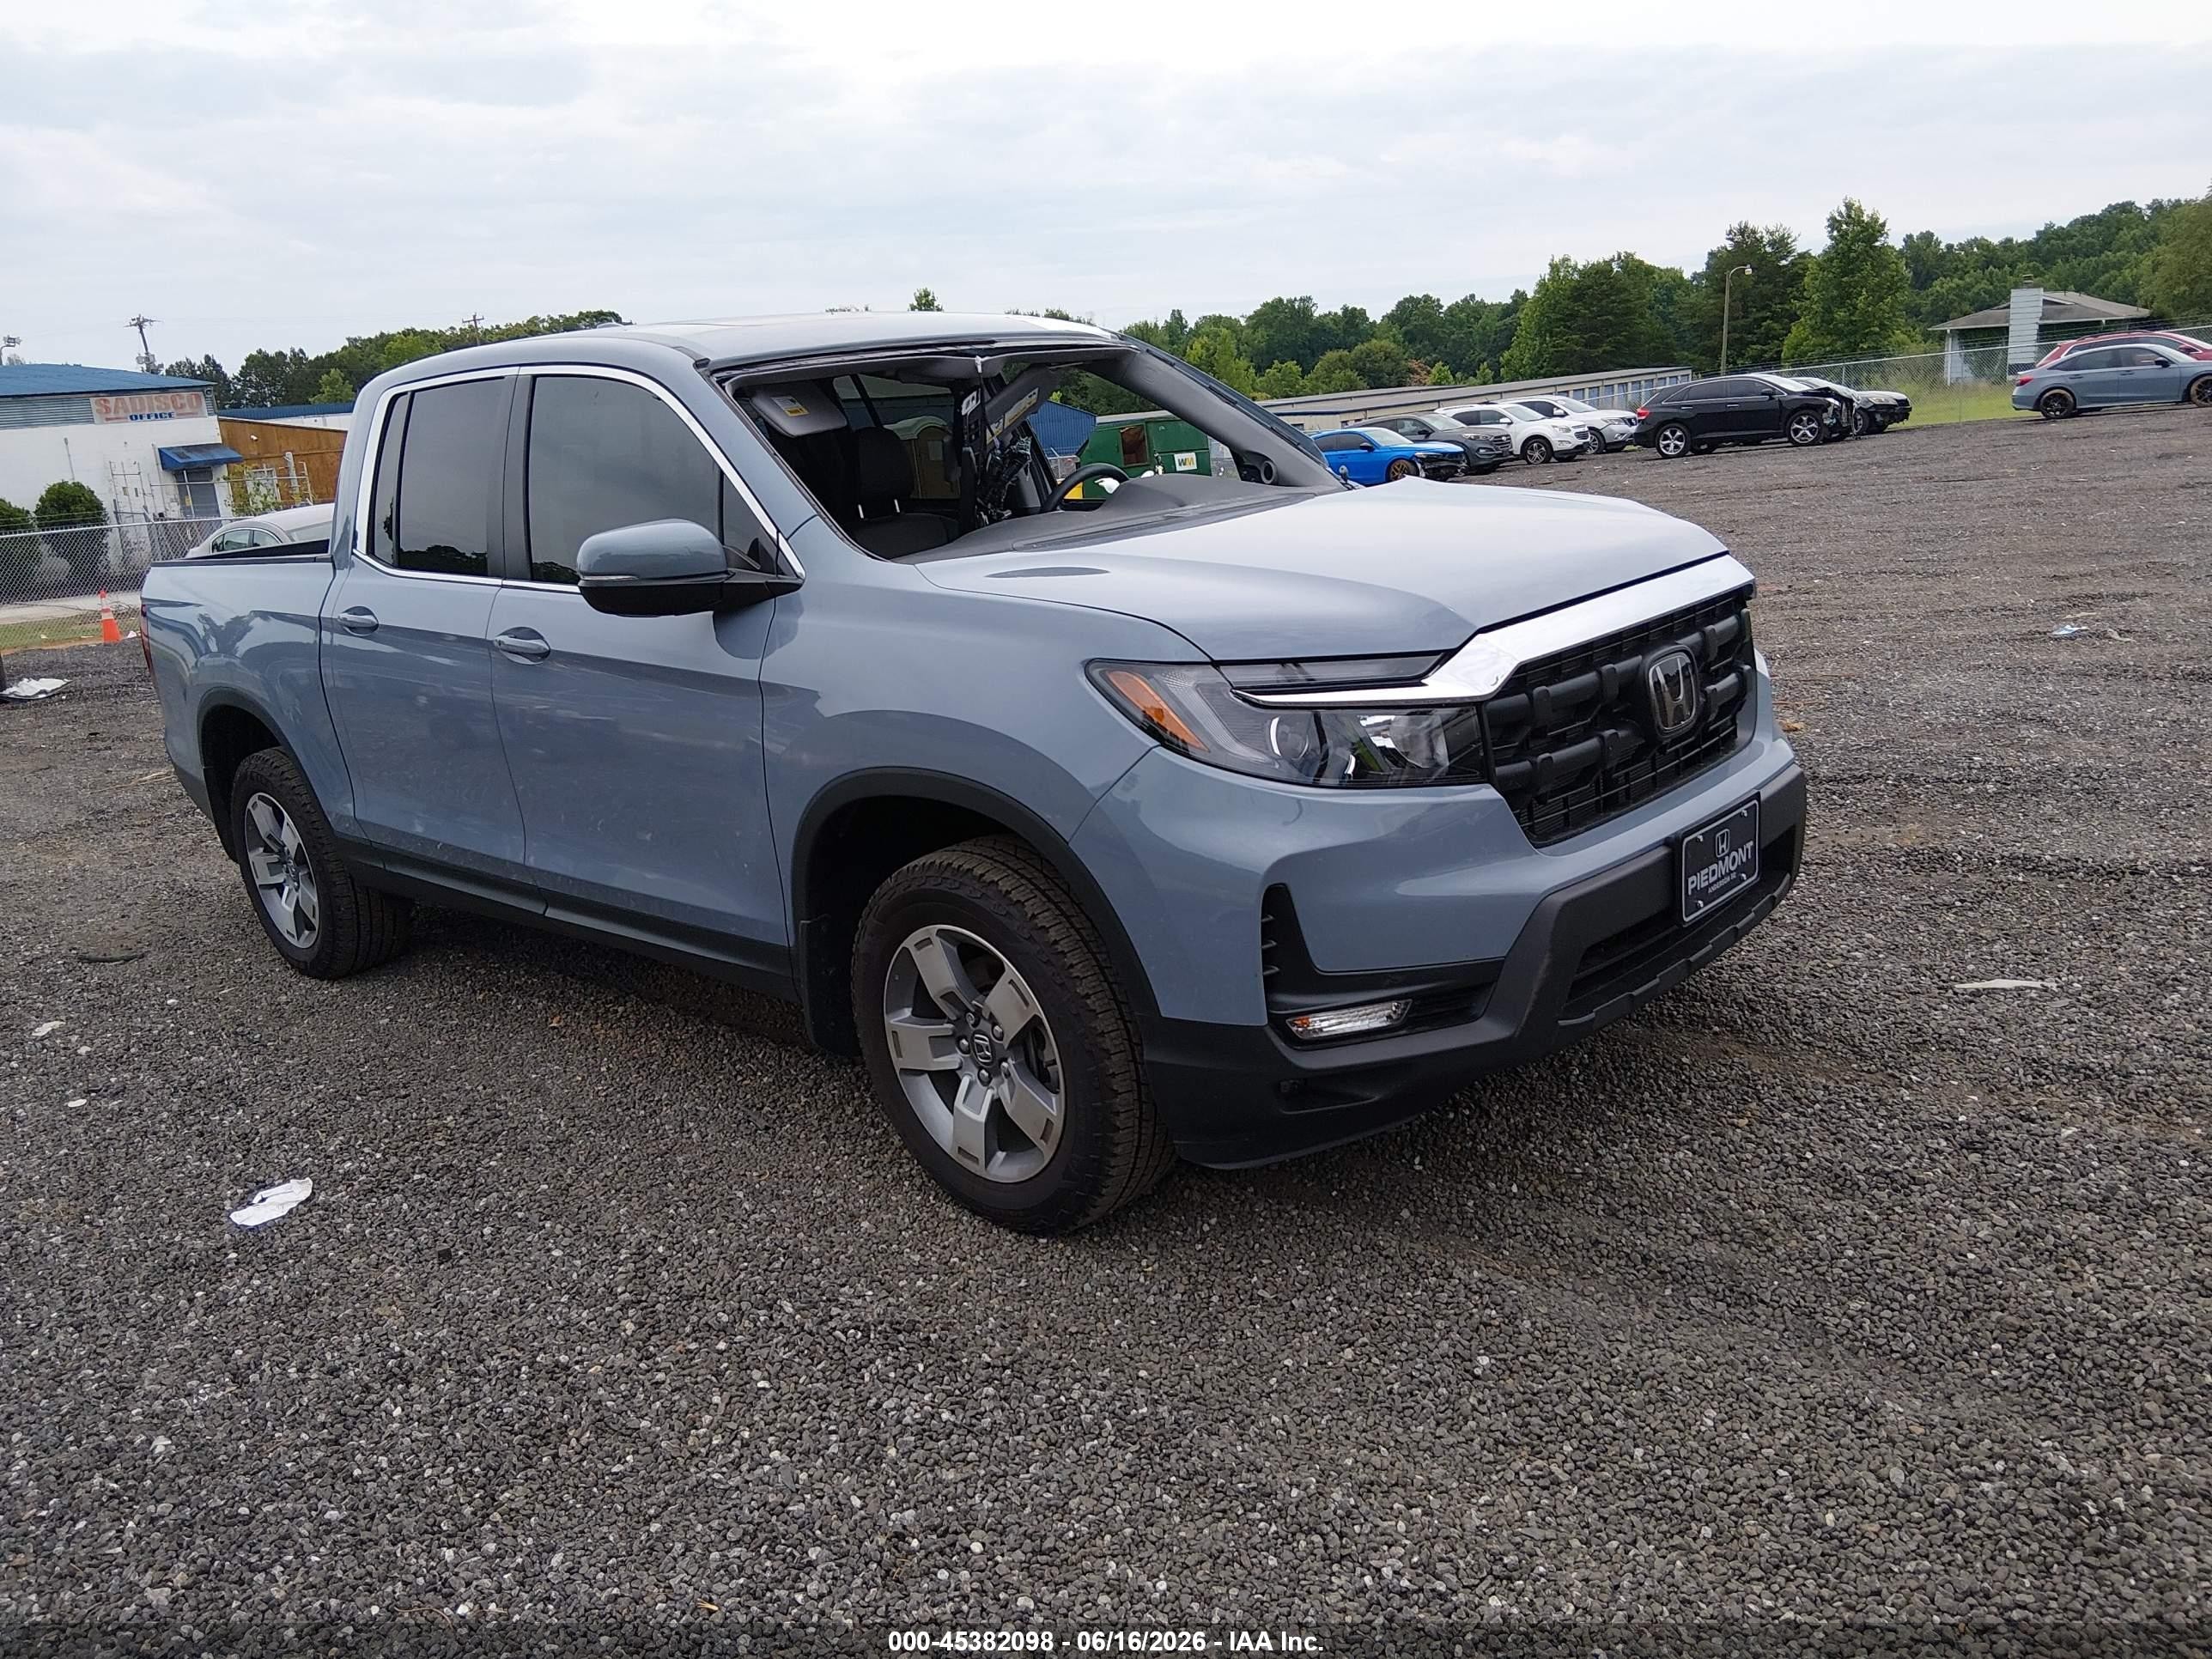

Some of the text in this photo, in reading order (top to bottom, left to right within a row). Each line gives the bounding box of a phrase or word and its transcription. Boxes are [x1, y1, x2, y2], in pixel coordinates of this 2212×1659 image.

[94, 394, 203, 416] SADISCO
[129, 412, 174, 422] OFFICE
[1177, 458, 1195, 467] WM
[1687, 841, 1753, 896] PIEDMONT
